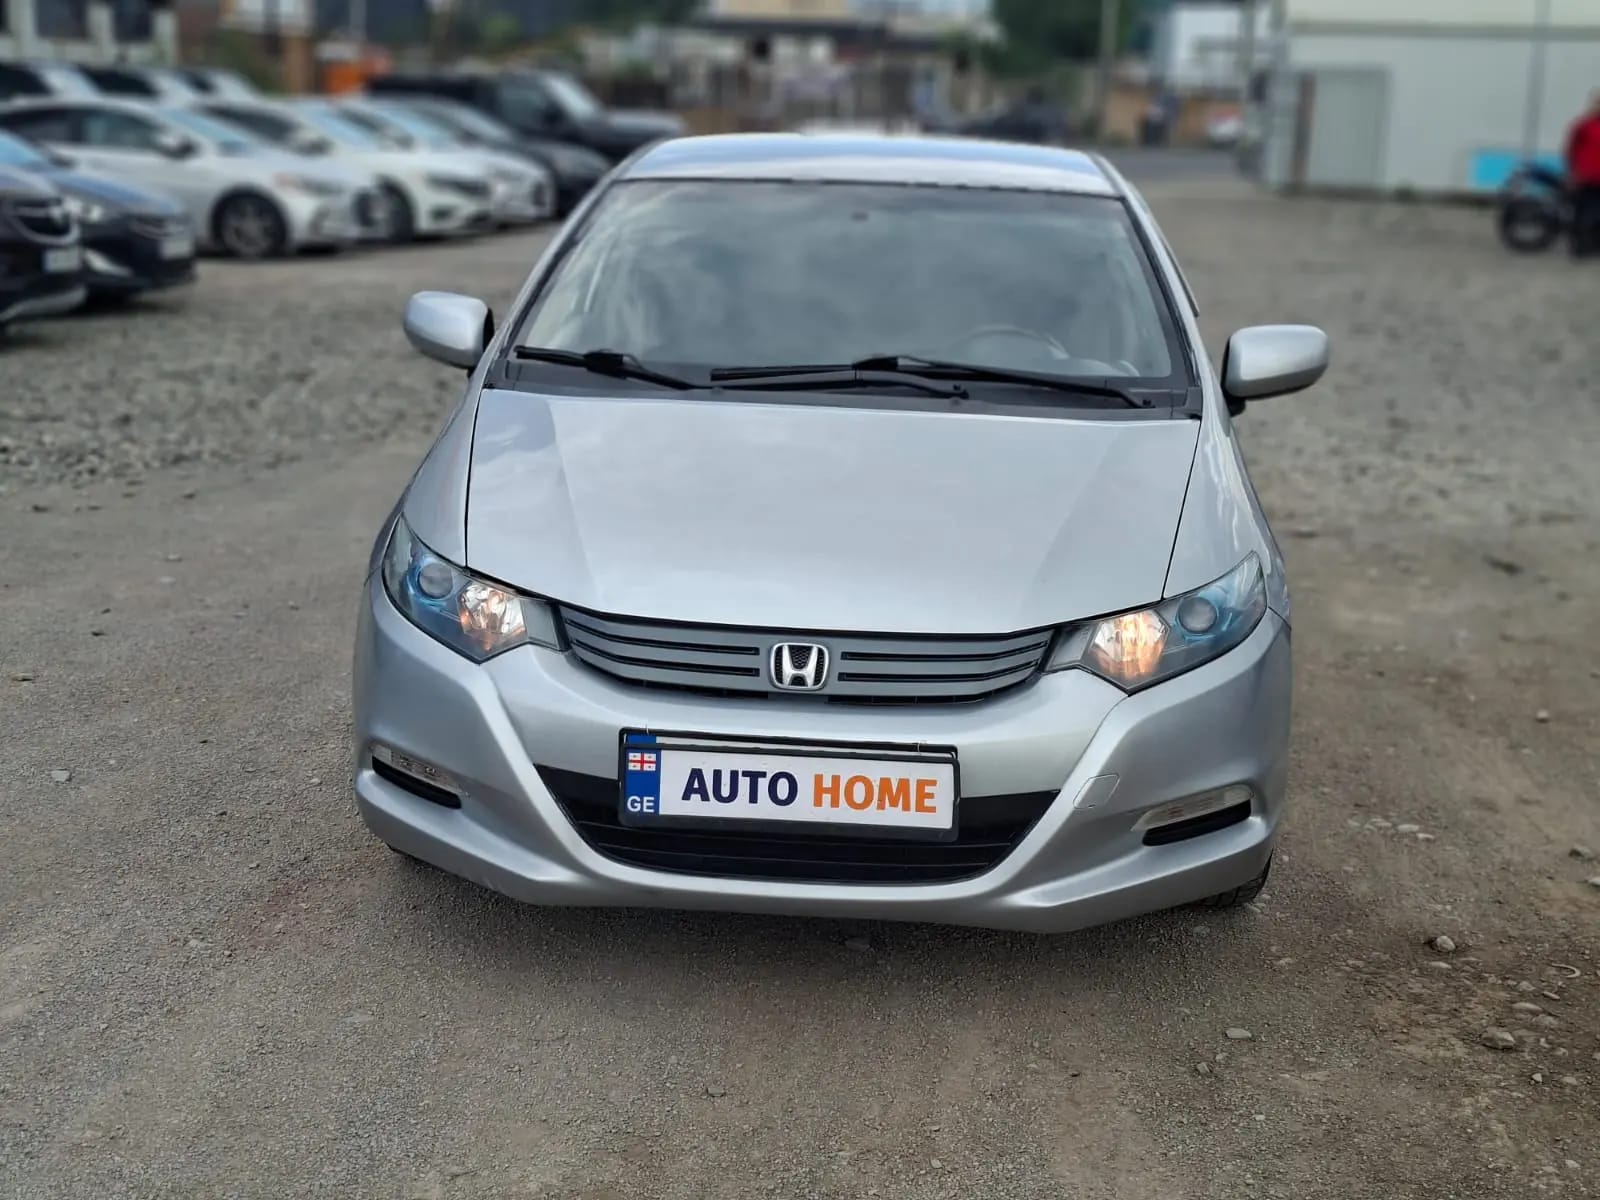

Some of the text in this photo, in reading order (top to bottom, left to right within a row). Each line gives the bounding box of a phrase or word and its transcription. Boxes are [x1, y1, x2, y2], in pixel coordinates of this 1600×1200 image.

[626, 796, 655, 814] GE
[681, 768, 938, 813] AUTO HOME
